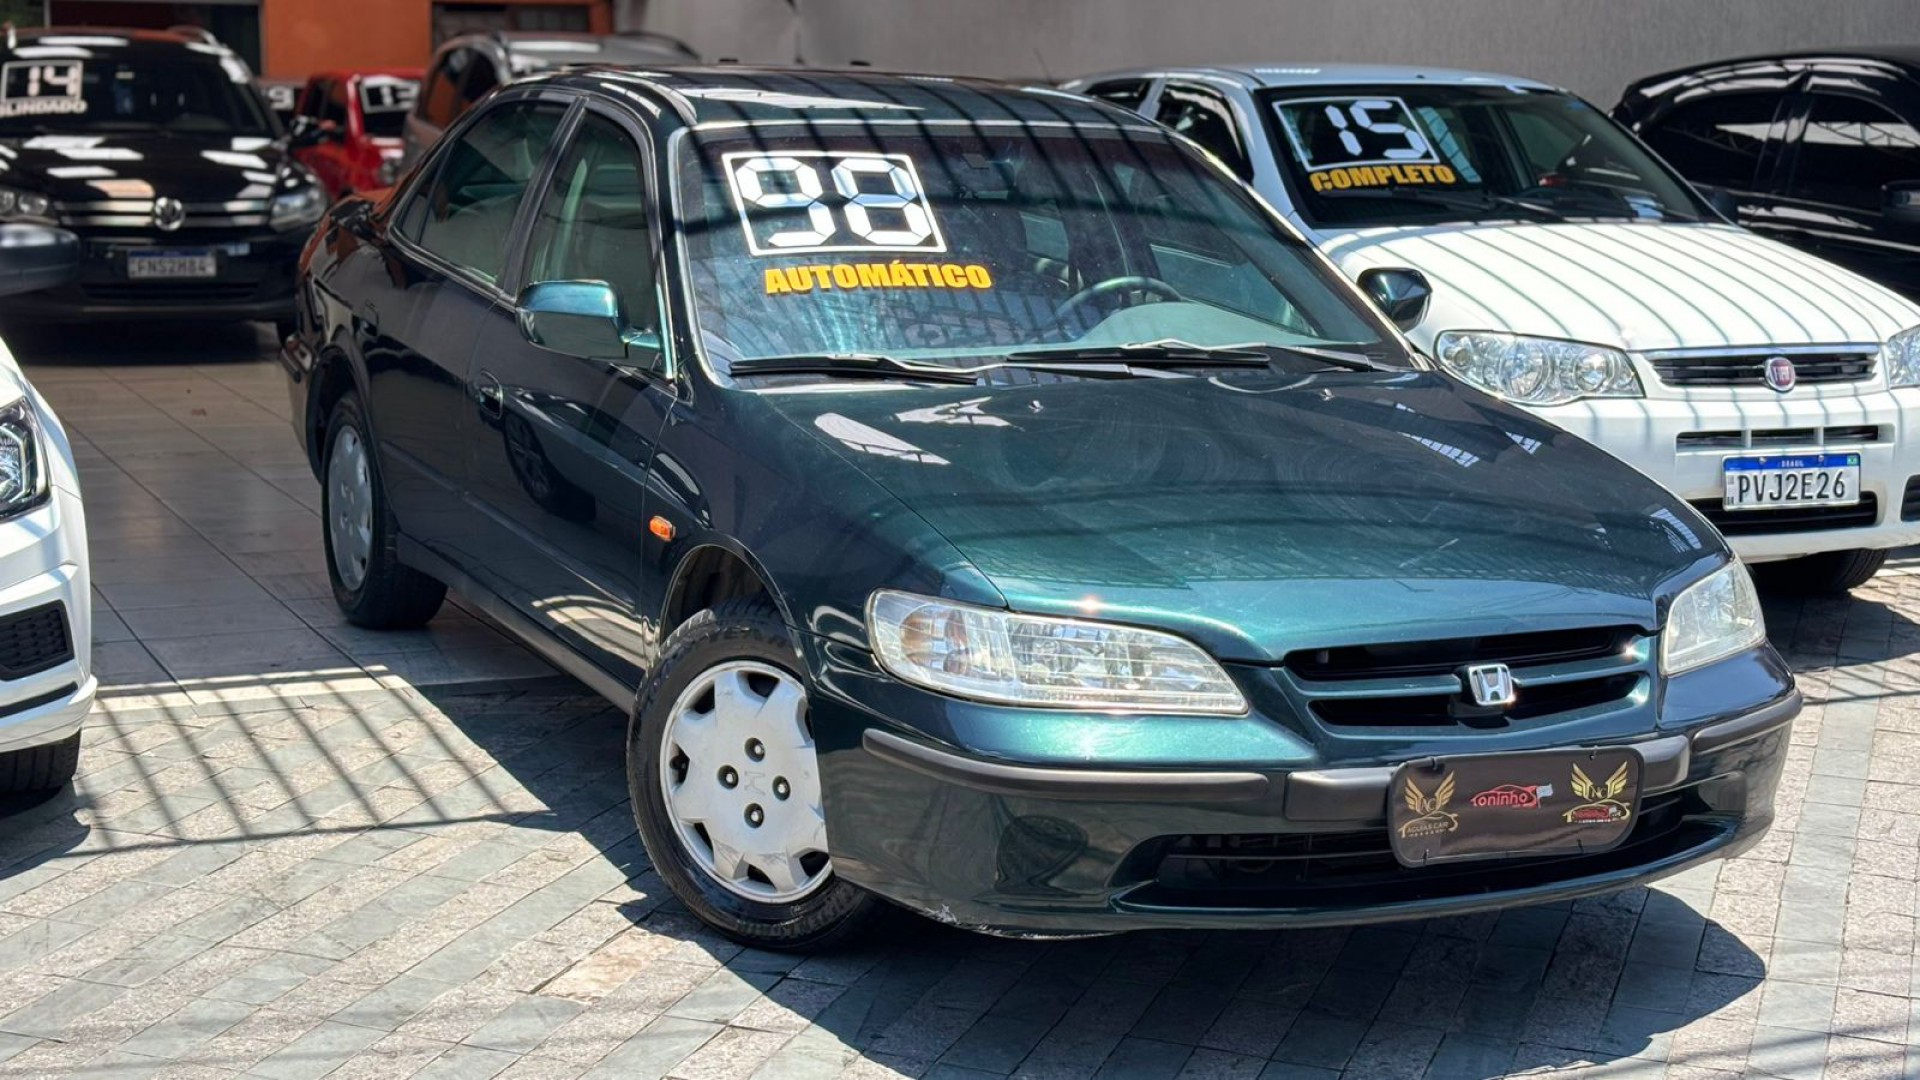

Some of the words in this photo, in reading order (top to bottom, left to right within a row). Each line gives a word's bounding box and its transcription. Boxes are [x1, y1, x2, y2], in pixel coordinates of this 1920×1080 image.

[28, 65, 78, 96] 14
[1324, 100, 1428, 159] 15
[1309, 164, 1456, 192] COMPLETO
[735, 157, 932, 247] 98
[765, 260, 992, 294] AUTOMÁTICO
[1738, 471, 1845, 502] PVJ2E26
